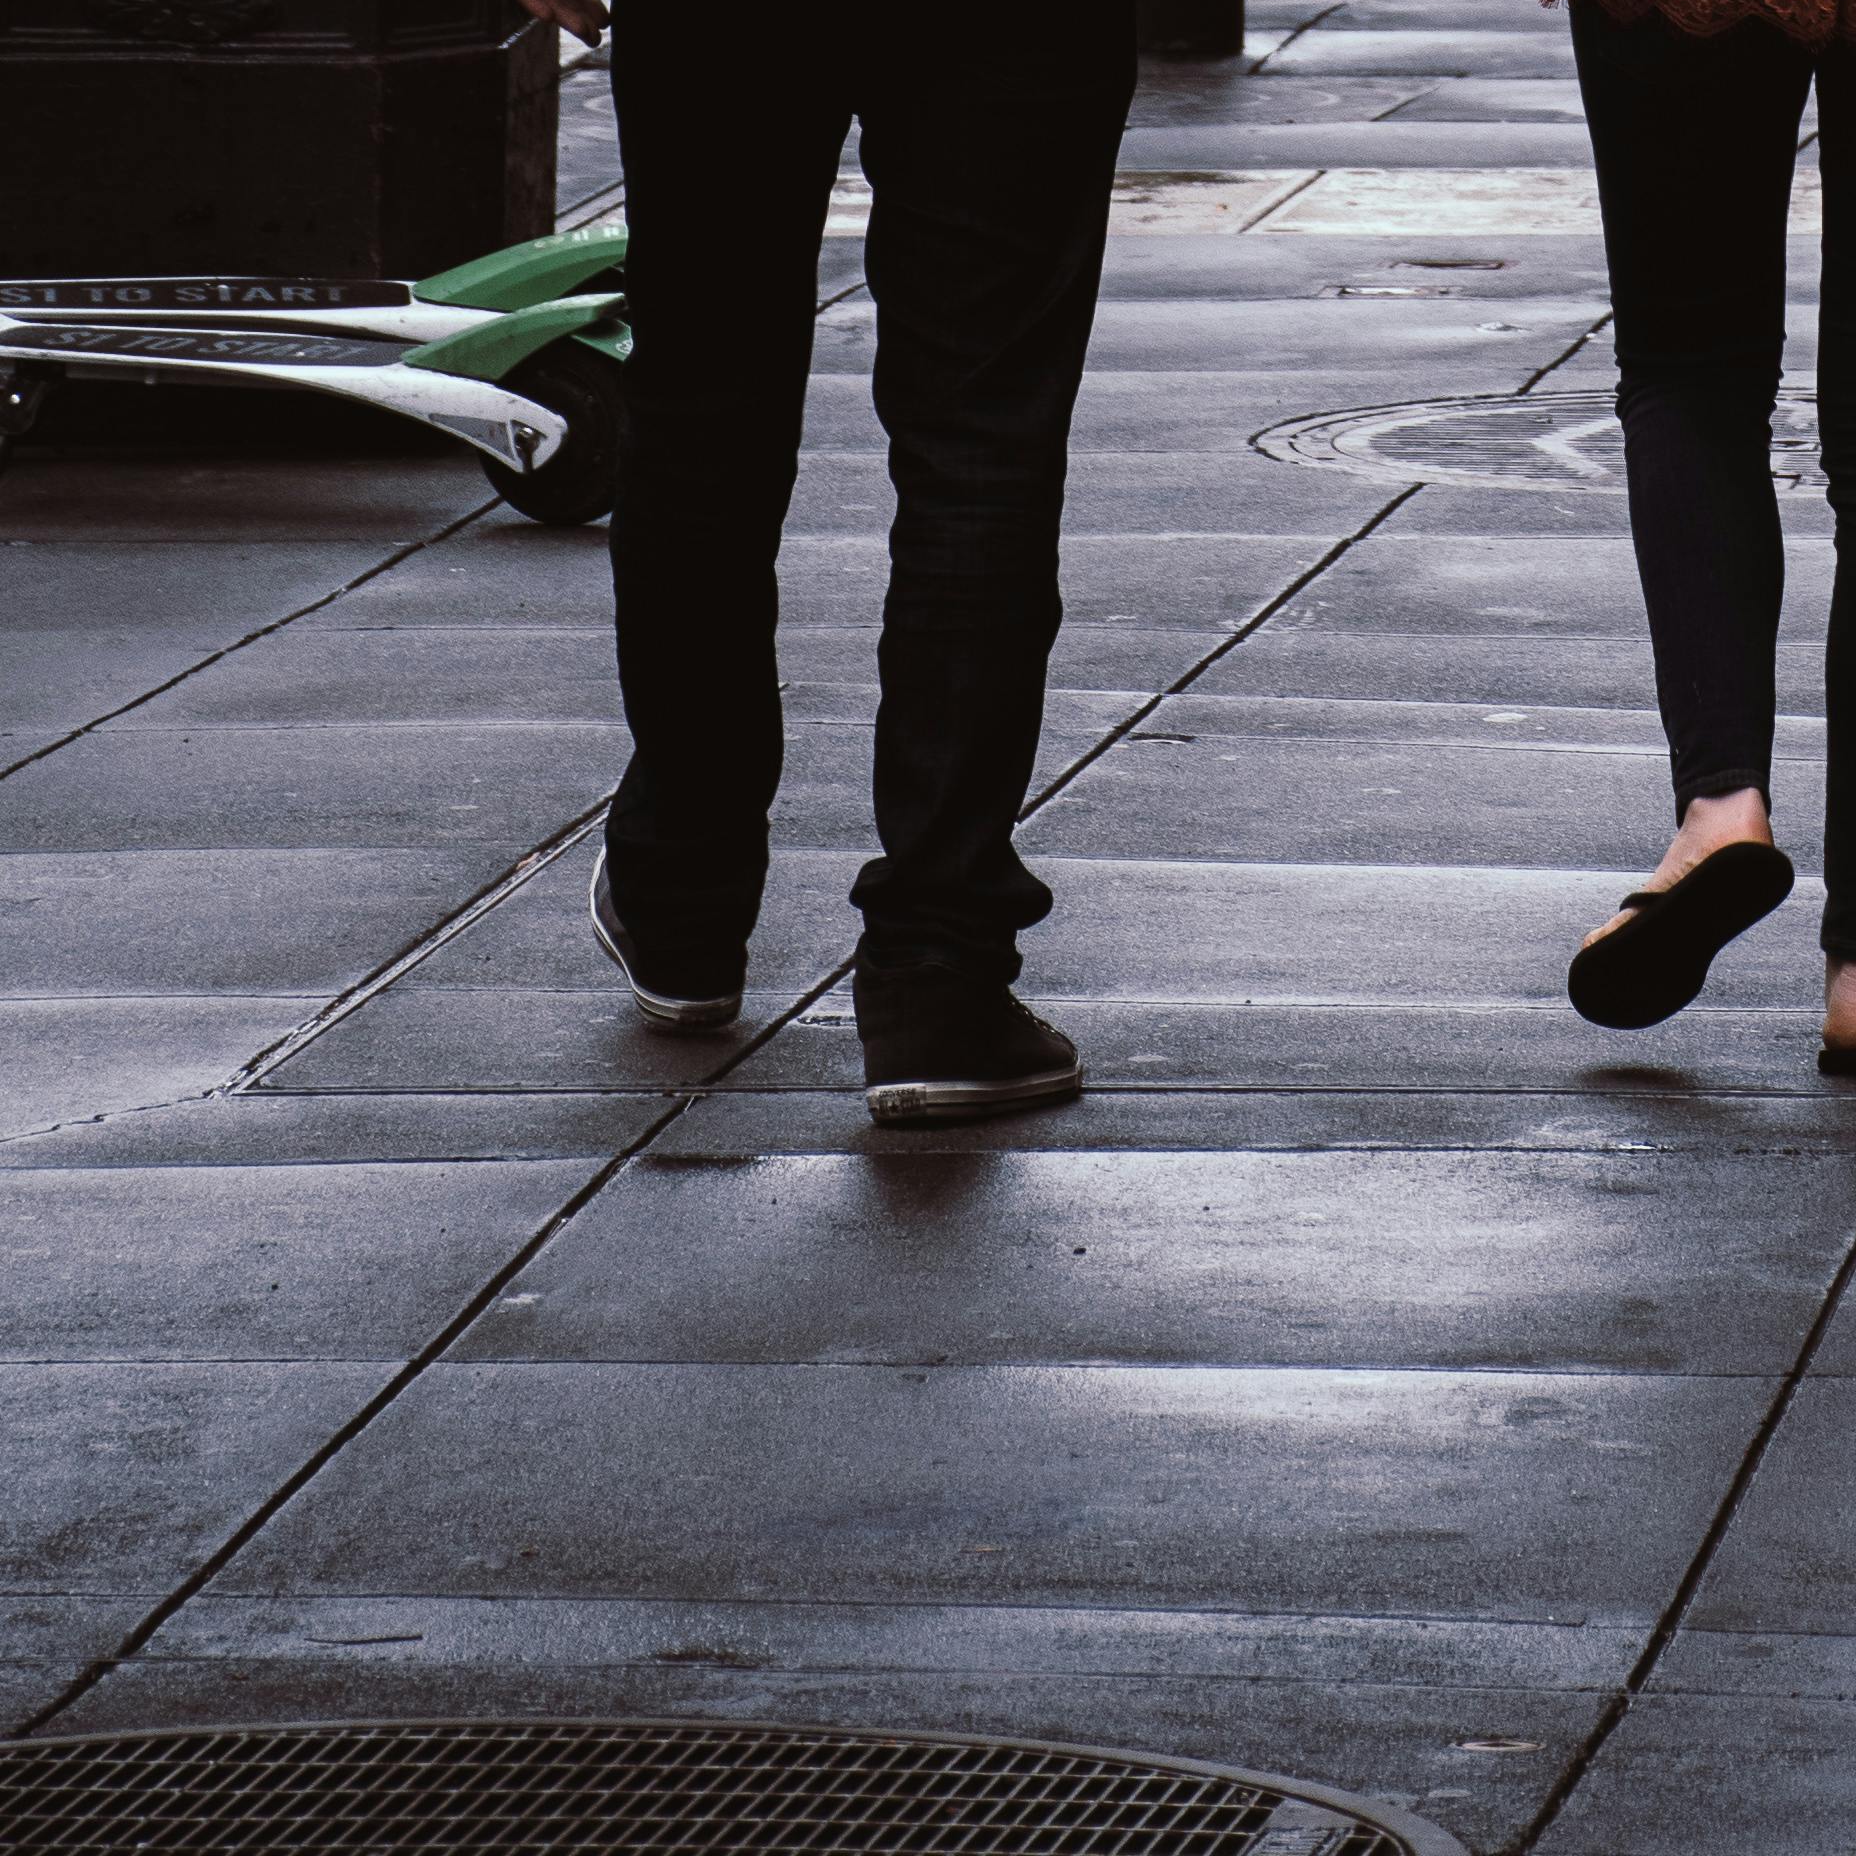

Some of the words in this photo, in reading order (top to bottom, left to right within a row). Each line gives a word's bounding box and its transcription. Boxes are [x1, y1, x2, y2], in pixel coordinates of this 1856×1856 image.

[82, 286, 152, 303] TO
[175, 285, 348, 303] START
[119, 335, 197, 351] TO
[198, 340, 372, 361] START
